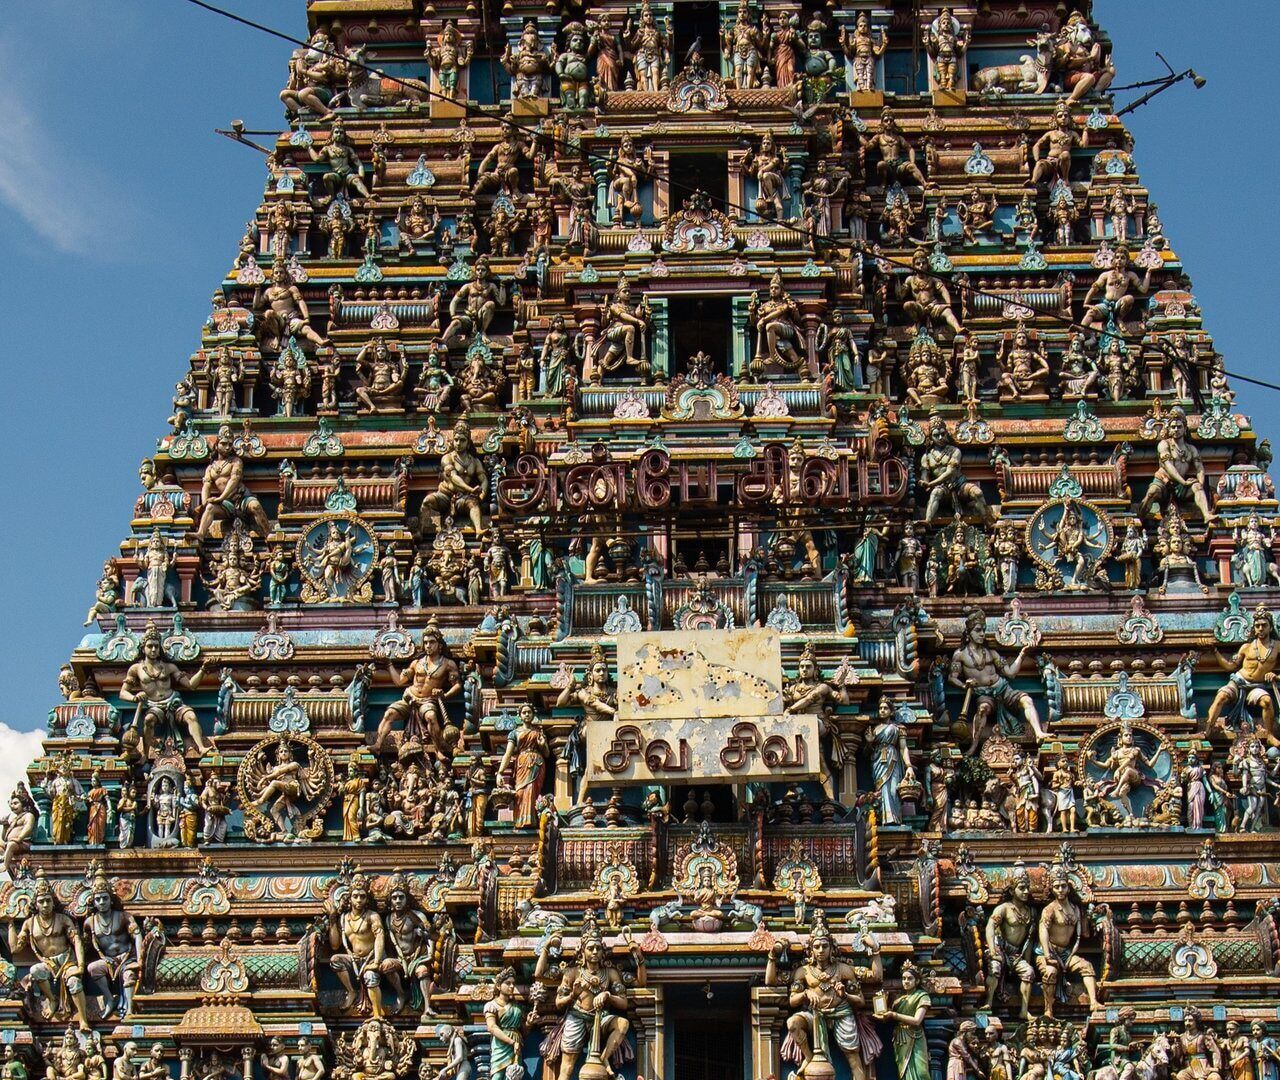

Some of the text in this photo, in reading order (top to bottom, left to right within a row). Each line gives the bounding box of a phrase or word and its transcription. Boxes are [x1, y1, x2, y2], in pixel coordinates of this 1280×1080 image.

[496, 438, 908, 508] அன்பே சிவம்
[603, 722, 805, 773] சிவ சிவ
